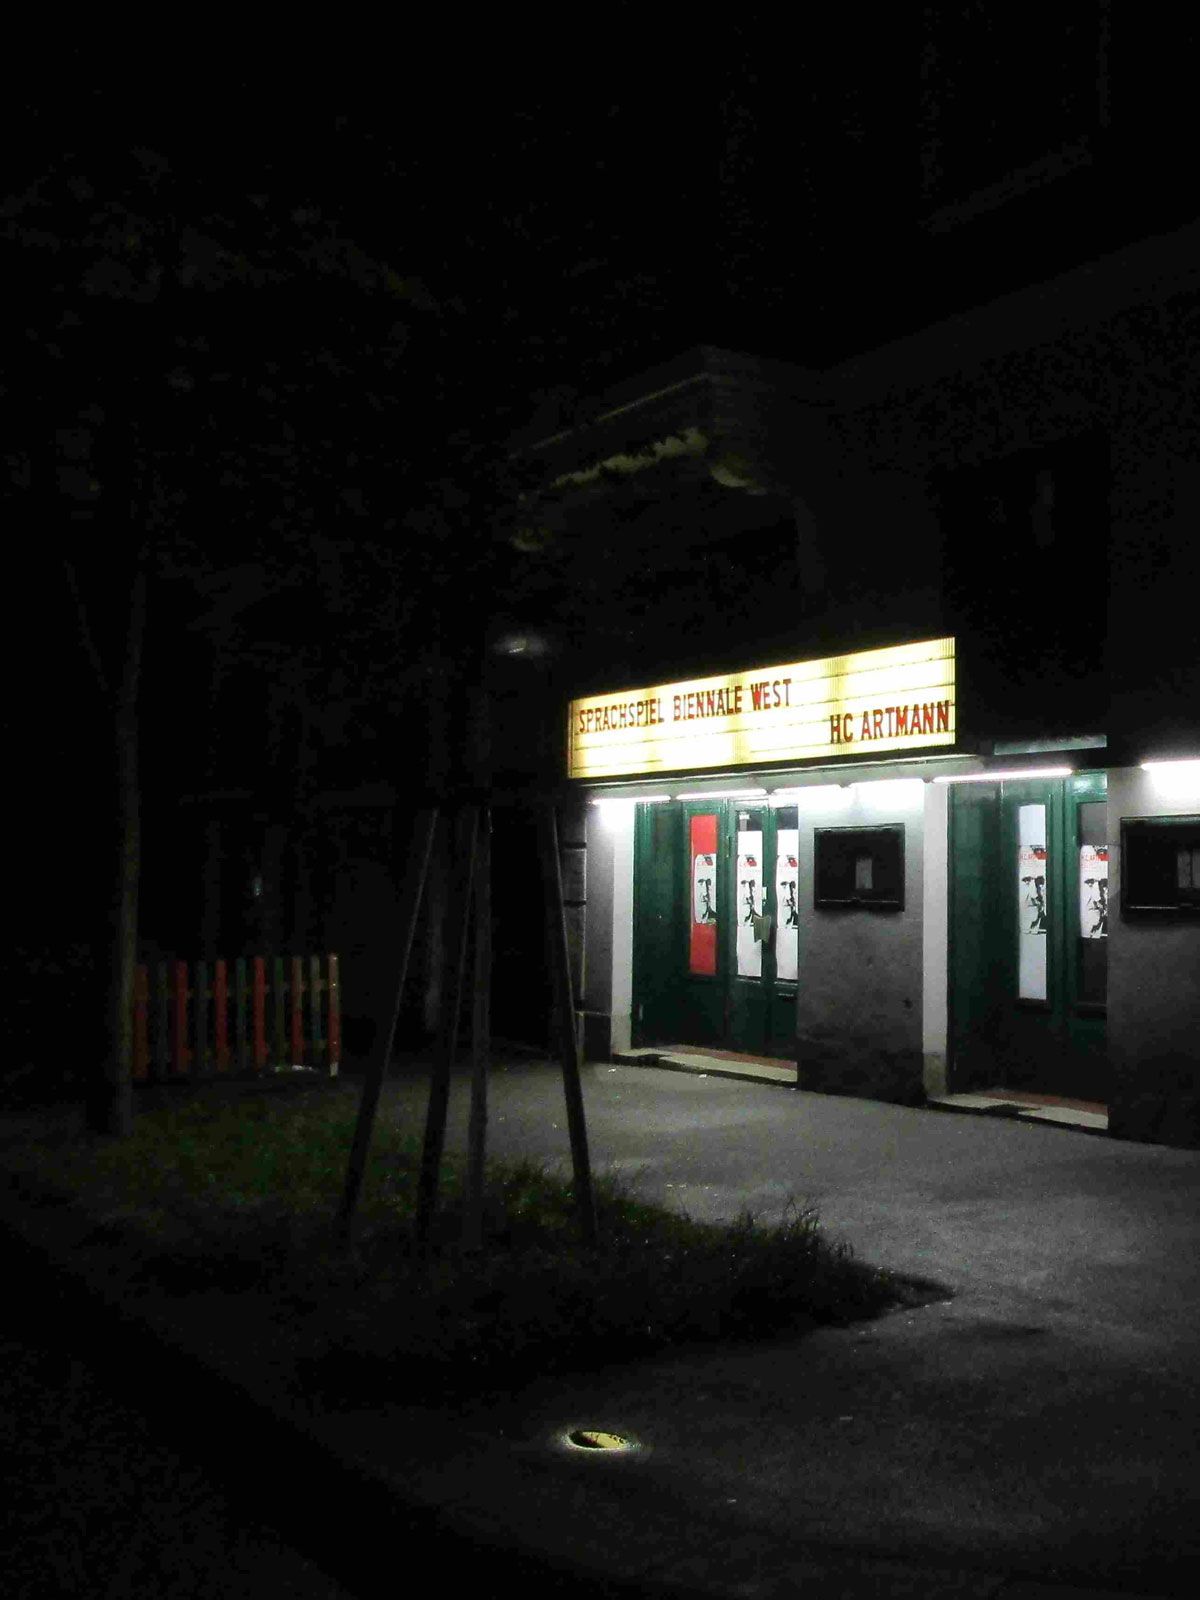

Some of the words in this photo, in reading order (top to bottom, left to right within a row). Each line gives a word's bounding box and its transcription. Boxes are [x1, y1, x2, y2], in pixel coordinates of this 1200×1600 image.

[578, 697, 665, 734] SPRACHSPIEL
[673, 684, 743, 722] BIENNALE
[750, 677, 792, 712] WEST
[829, 713, 854, 744] HC
[860, 699, 951, 741] ARTMANN
